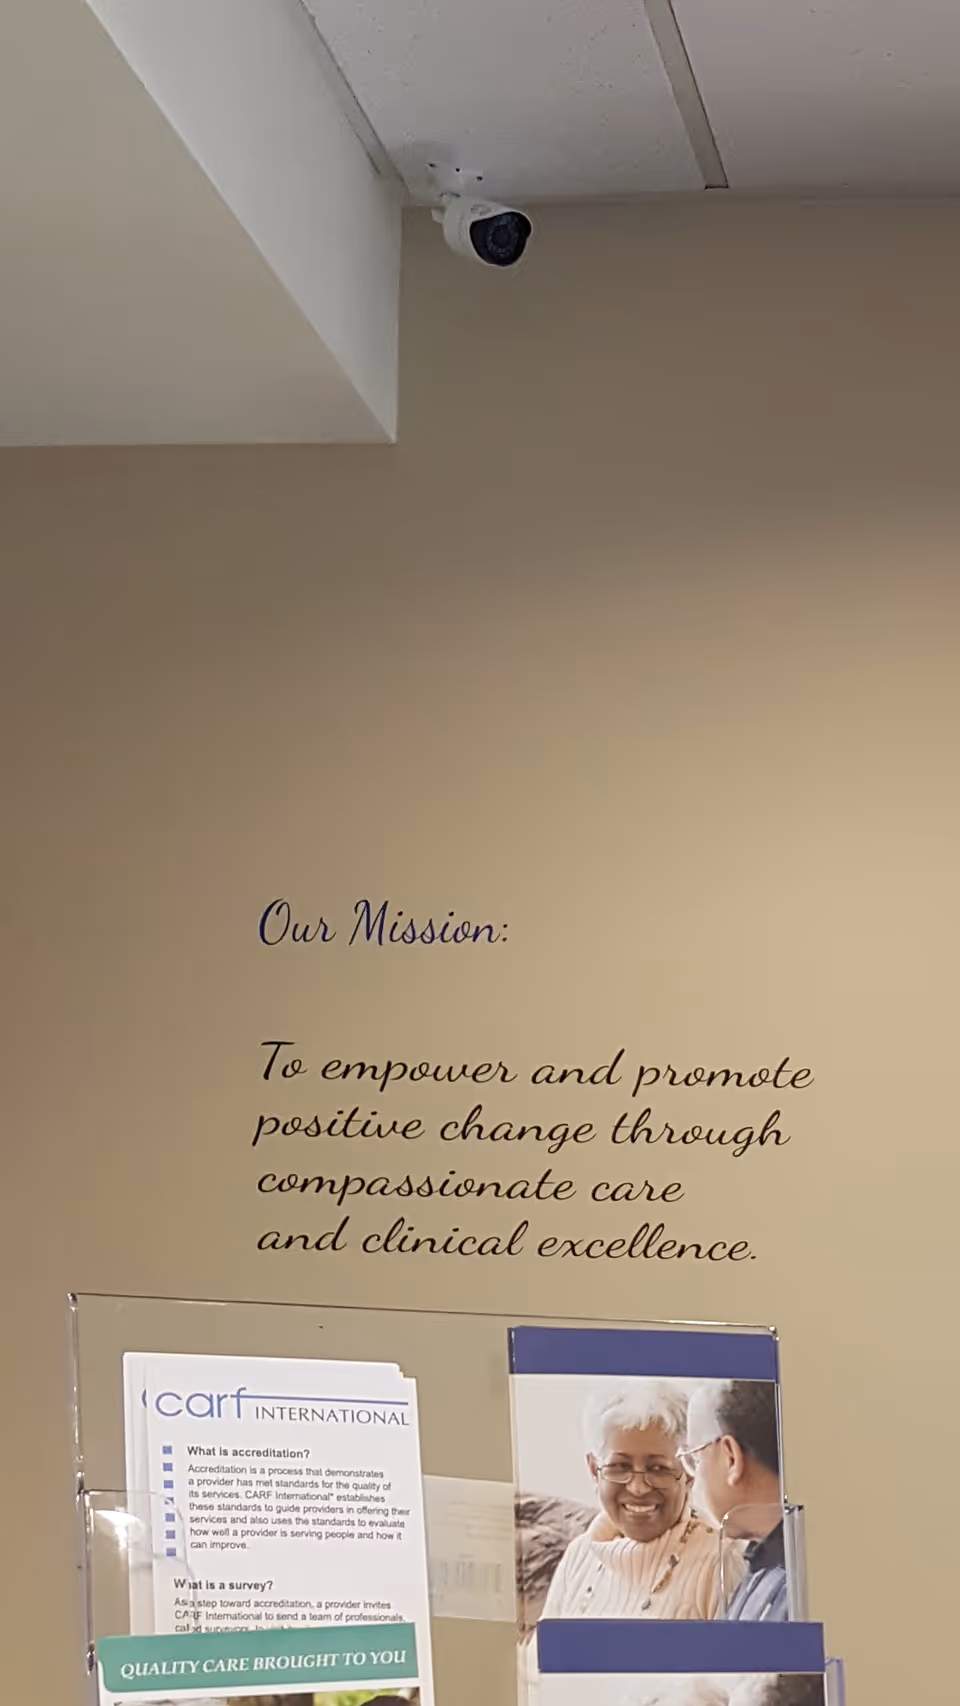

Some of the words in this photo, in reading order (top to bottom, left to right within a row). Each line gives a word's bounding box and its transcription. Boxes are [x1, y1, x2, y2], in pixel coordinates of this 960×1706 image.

[259, 898, 336, 946] Our
[348, 898, 509, 947] Mission:
[261, 1041, 307, 1082] To
[321, 1056, 518, 1092] empower
[531, 1049, 623, 1086] and
[632, 1056, 815, 1097] promote
[252, 1107, 424, 1147] positive
[440, 1105, 597, 1154] change
[610, 1108, 790, 1157] through
[257, 1168, 577, 1206] compassionate
[591, 1177, 685, 1203] care
[257, 1216, 350, 1253] and
[361, 1217, 529, 1256] clinical
[537, 1223, 758, 1261] excellence.
[155, 1387, 247, 1419] carf
[255, 1405, 409, 1426] INTERNATIONAL
[187, 1446, 216, 1456] What
[219, 1447, 228, 1457] is
[232, 1448, 310, 1459] accreditation?
[188, 1465, 247, 1474] Accreditation
[250, 1466, 257, 1474] is
[268, 1467, 303, 1477] process
[306, 1468, 322, 1476] that
[325, 1469, 383, 1478] demonstrates
[197, 1477, 234, 1487] provider
[237, 1478, 252, 1486] has
[275, 1480, 319, 1488] standards
[322, 1480, 333, 1488] for
[336, 1481, 349, 1489] the
[353, 1481, 380, 1492] quality
[383, 1482, 391, 1491] of
[189, 1490, 199, 1498] its
[202, 1491, 242, 1499] services.
[245, 1491, 272, 1499] CARF
[336, 1493, 385, 1503] establishes
[190, 1502, 215, 1511] these
[218, 1503, 261, 1512] standards
[276, 1504, 300, 1515] guide
[303, 1505, 343, 1515] providers
[357, 1507, 389, 1517] offering
[392, 1508, 410, 1516] their
[190, 1516, 227, 1524] services
[230, 1515, 247, 1524] and
[250, 1516, 268, 1525] also
[271, 1518, 292, 1526] uses
[312, 1518, 355, 1527] standards
[358, 1519, 366, 1527] to
[369, 1519, 405, 1528] evaluate
[191, 1528, 208, 1537] how
[212, 1528, 230, 1536] well
[241, 1529, 277, 1540] provider
[290, 1531, 322, 1540] serving
[325, 1532, 354, 1541] people
[357, 1531, 373, 1539] and
[376, 1532, 393, 1540] how
[396, 1532, 402, 1541] it
[210, 1541, 249, 1552] improve.
[206, 1581, 215, 1590] is
[229, 1580, 273, 1592] survey?
[198, 1599, 217, 1610] step
[220, 1599, 251, 1608] toward
[254, 1600, 313, 1609] accreditation,
[325, 1600, 360, 1610] provider
[364, 1601, 390, 1609] invites
[206, 1611, 262, 1620] International
[277, 1612, 298, 1621] send
[309, 1613, 331, 1621] team
[334, 1612, 343, 1621] of
[121, 1660, 199, 1679] QUALITY
[203, 1657, 250, 1673] CARE
[254, 1653, 339, 1671] BROUGHT
[343, 1652, 365, 1666] TO
[369, 1650, 406, 1664] YOU
